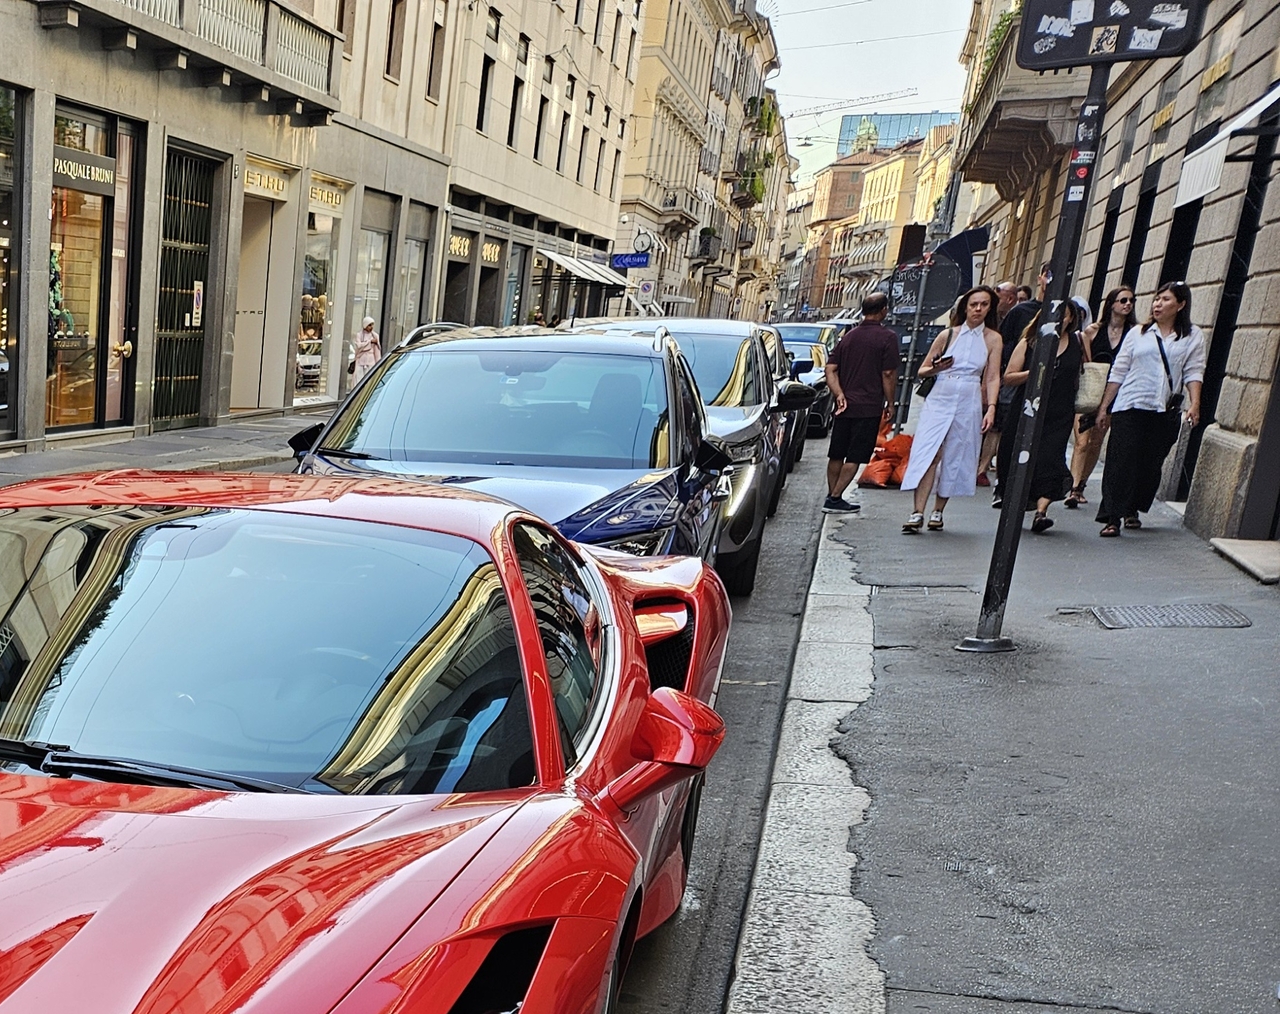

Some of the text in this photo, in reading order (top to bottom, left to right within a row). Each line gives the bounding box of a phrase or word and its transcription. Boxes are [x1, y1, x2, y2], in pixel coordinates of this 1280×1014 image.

[54, 158, 113, 184] PASQUALE BRUNI
[244, 170, 284, 192] ETRO
[310, 186, 341, 205] ETRO
